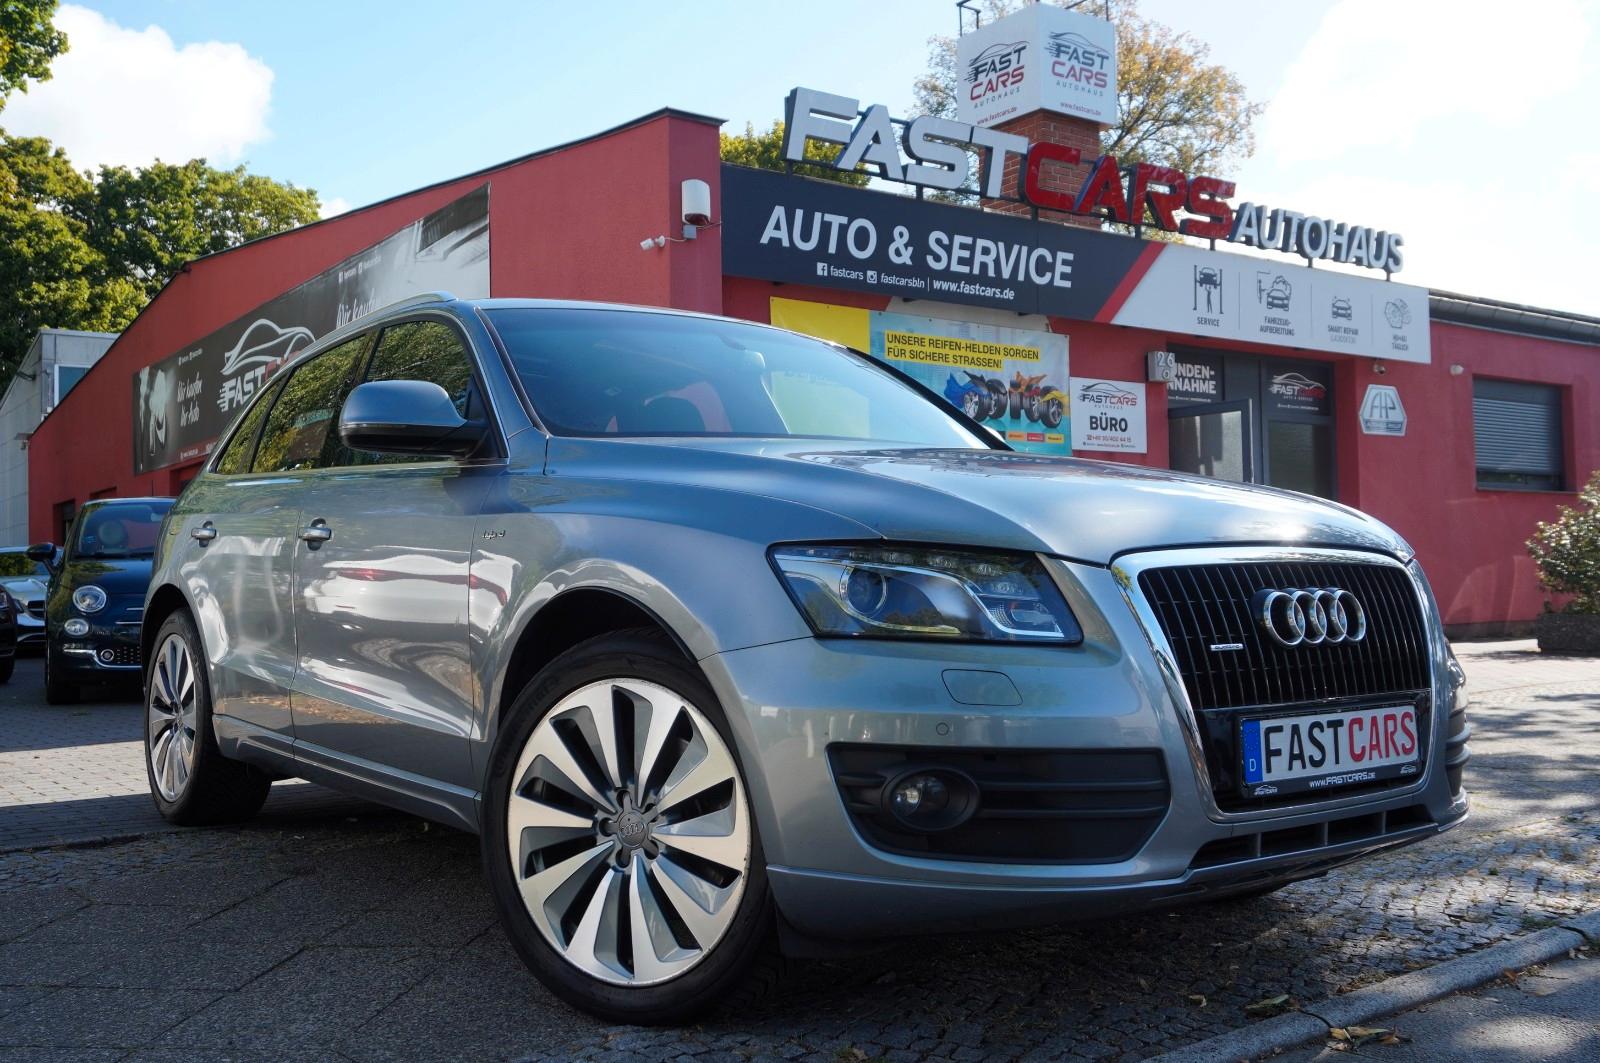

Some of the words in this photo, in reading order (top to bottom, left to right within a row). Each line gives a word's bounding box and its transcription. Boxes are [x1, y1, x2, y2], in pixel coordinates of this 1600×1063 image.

[972, 45, 1027, 82] FAST
[1049, 43, 1110, 70] FAST
[970, 65, 1025, 101] CARS
[1051, 60, 1108, 89] CARS
[974, 87, 1021, 109] AUTOHAUS
[1056, 80, 1104, 97] AUTOHAUS
[760, 205, 877, 260] AUTO
[888, 226, 914, 265] &
[926, 231, 1074, 288] SERVICE
[1229, 201, 1405, 273] AUTOHAUS
[830, 265, 864, 280] fastcars
[880, 273, 925, 288] fastcarsbln
[933, 279, 1015, 300] www.fastcars.de
[1197, 316, 1220, 328] SERVICE
[887, 333, 926, 348] UNSERE
[928, 338, 1002, 356] REIFEN-HELDEN
[1003, 345, 1039, 360] SORGEN
[887, 345, 907, 359] FÜR
[909, 350, 950, 363] SICHERE
[952, 354, 1003, 369] STRASSEN!
[1157, 351, 1175, 368] 26
[1081, 393, 1137, 406] FASTCARS
[1089, 411, 1128, 433] BÜRO
[1249, 758, 1257, 772] D
[1263, 711, 1416, 774] FASTCARS
